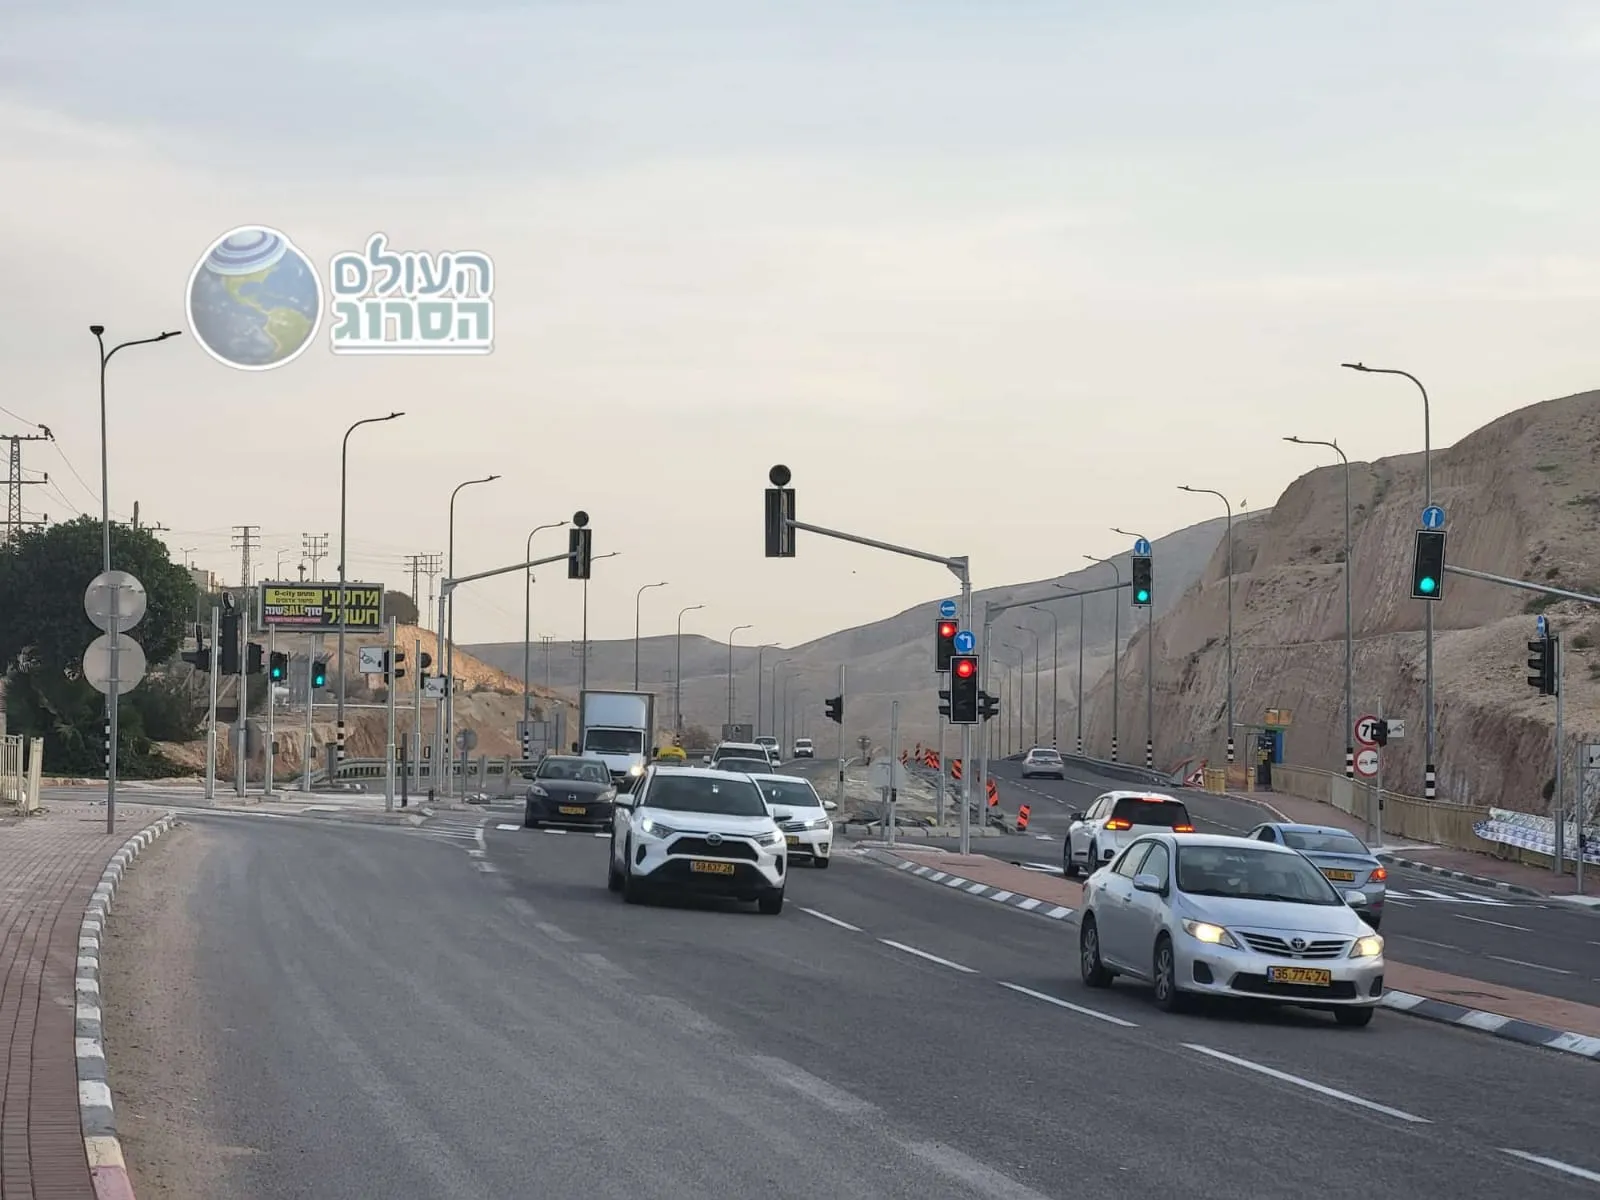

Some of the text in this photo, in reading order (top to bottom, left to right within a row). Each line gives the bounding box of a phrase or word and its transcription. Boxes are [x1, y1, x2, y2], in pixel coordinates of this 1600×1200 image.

[265, 605, 322, 616] סוף SALE שנה
[324, 606, 379, 625] חשמל
